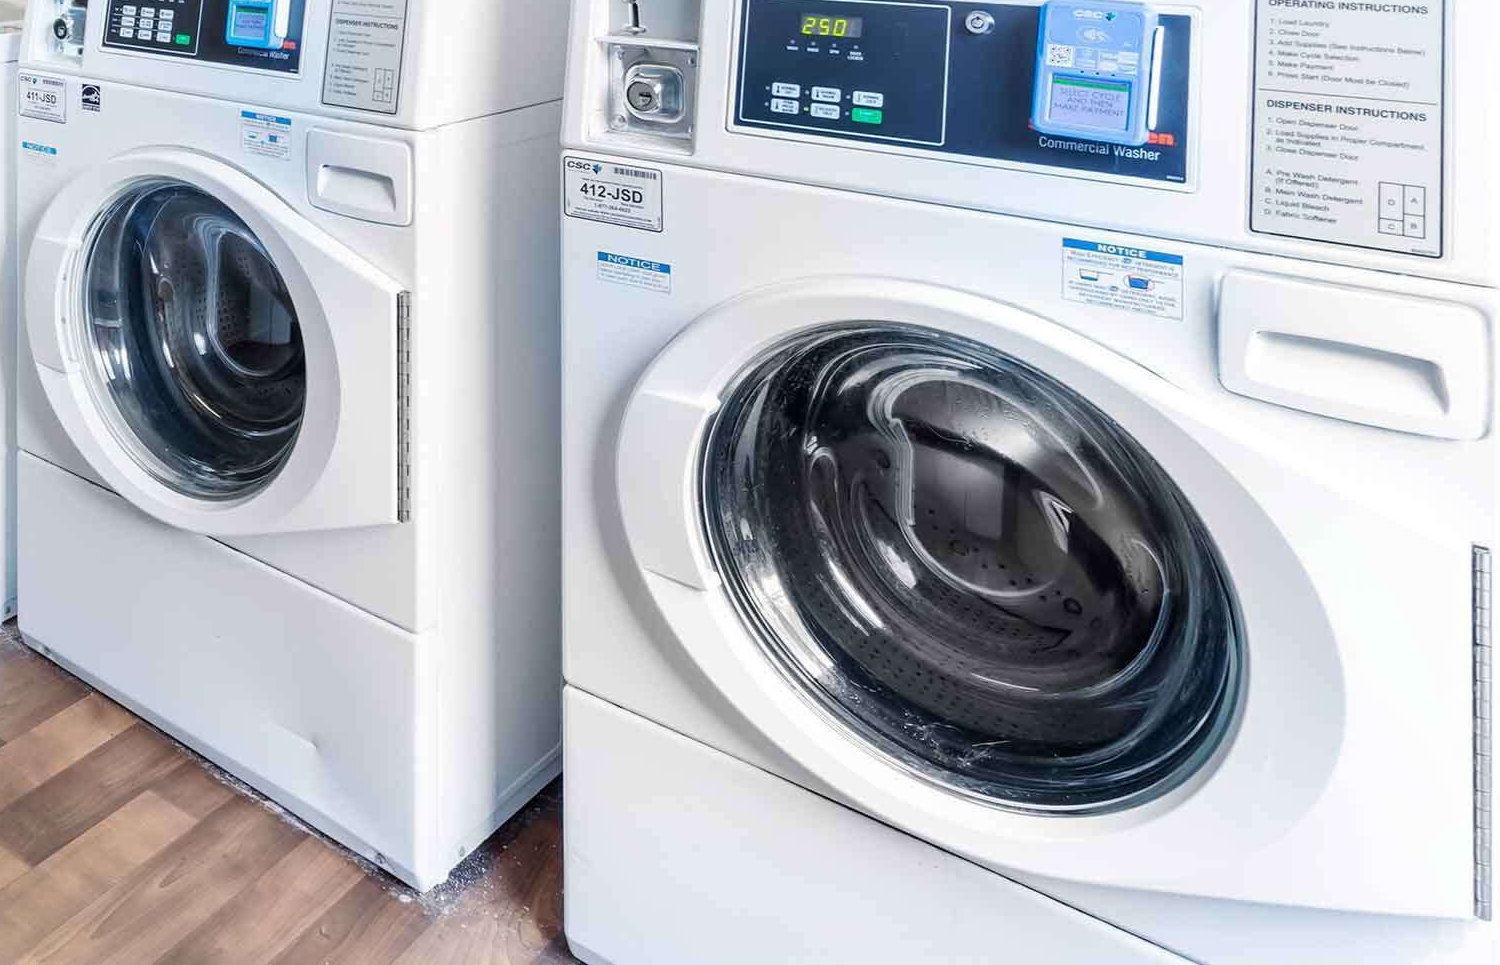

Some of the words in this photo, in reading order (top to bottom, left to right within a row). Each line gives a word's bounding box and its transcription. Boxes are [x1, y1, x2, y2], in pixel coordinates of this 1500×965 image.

[1338, 1, 1429, 15] INSTRUCTIONS
[1278, 18, 1297, 26] Load
[27, 91, 57, 104] 411-JSD
[1266, 99, 1333, 114] DISPENSER
[1335, 105, 1427, 122] INSTRUCTIONS
[1038, 136, 1109, 156] Commercial
[1112, 145, 1161, 161] Washer
[567, 160, 591, 171] CSC
[580, 182, 643, 204] 412-JSD
[1097, 243, 1147, 259] NOTICE
[607, 254, 661, 272] NOTICE
